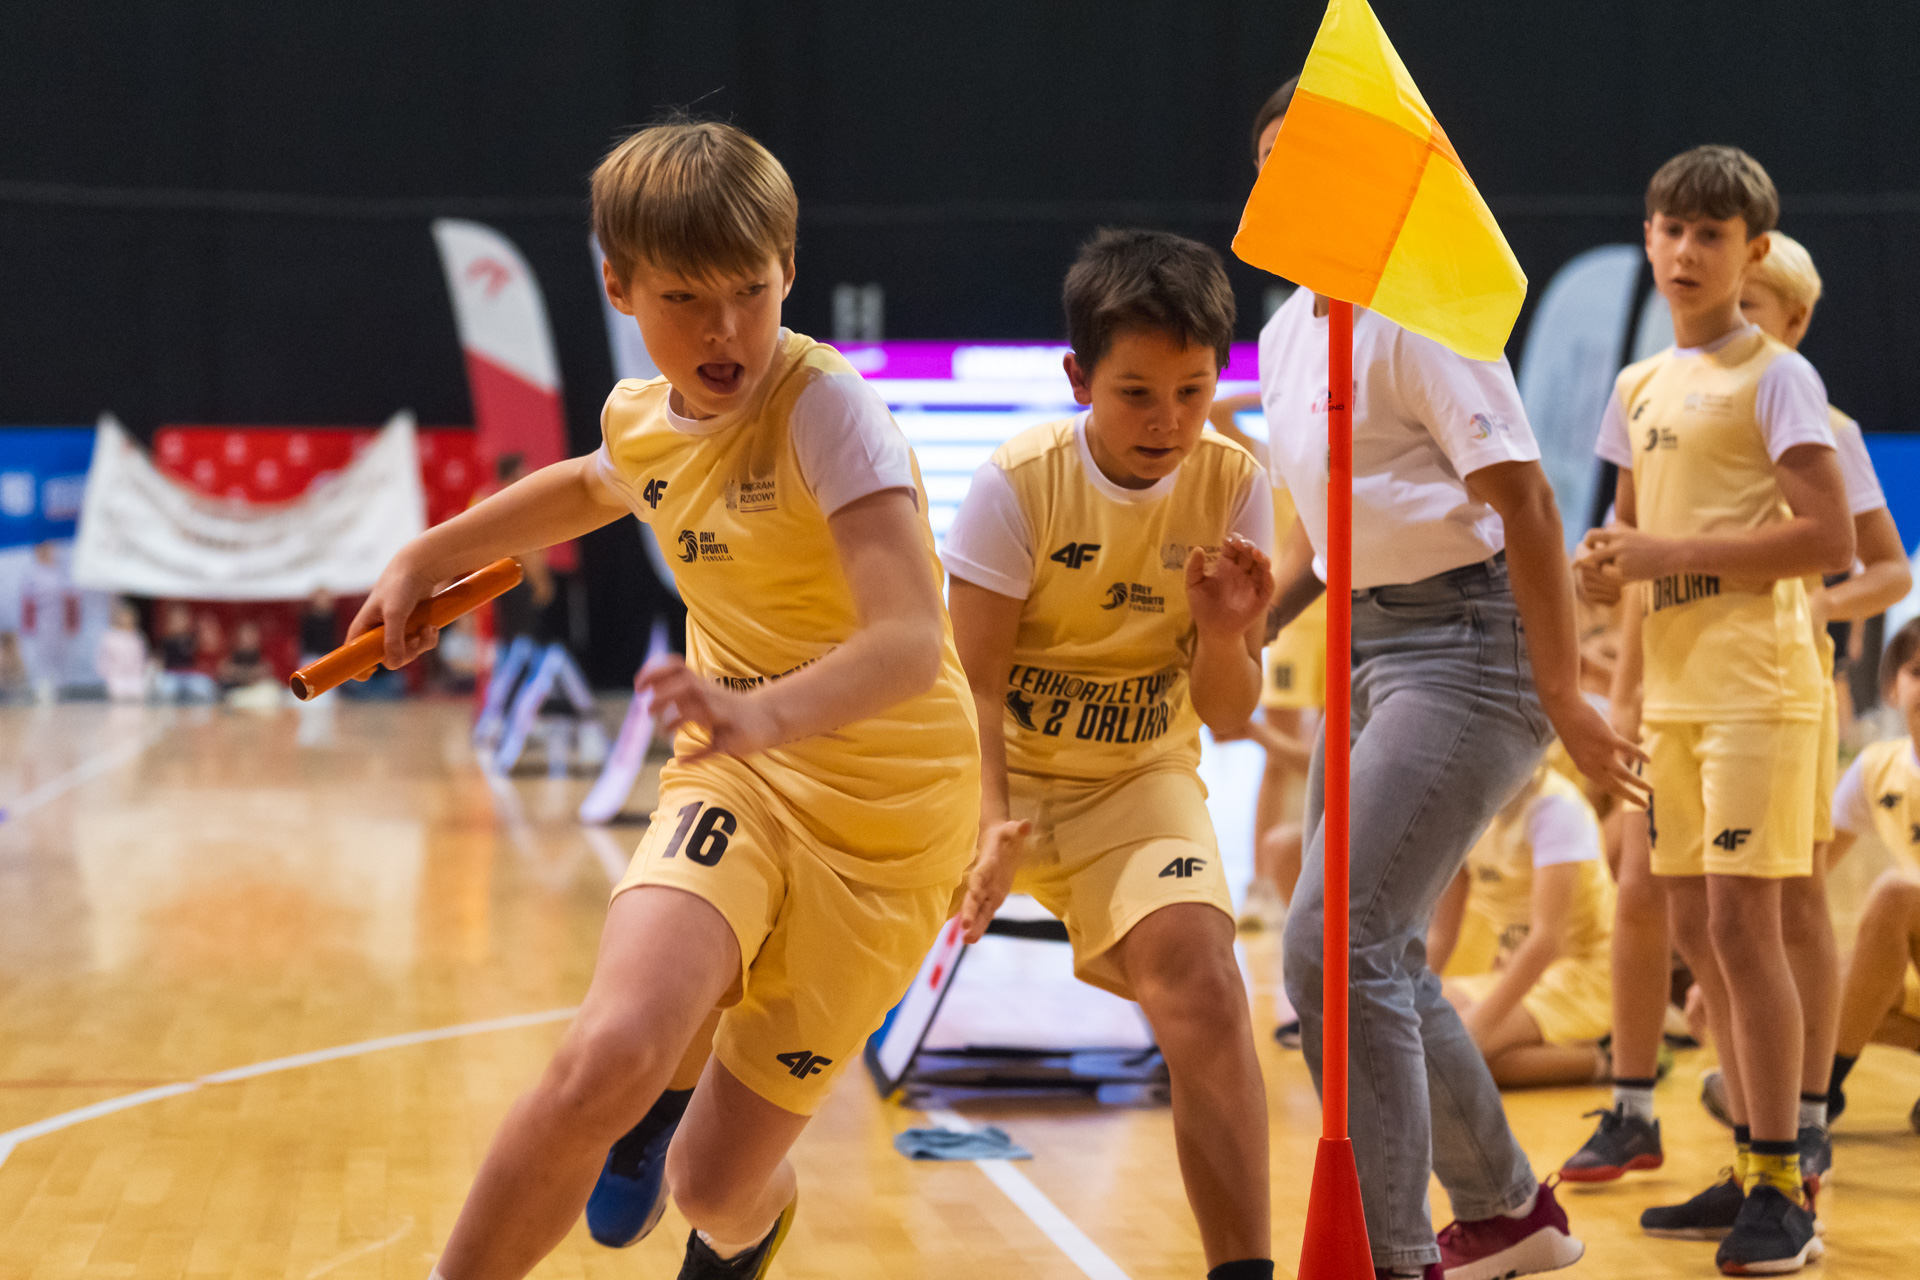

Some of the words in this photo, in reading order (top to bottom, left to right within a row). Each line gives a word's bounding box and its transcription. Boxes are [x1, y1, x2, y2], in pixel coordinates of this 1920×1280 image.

[643, 478, 668, 510] 4F
[741, 481, 775, 492] PRGRAM
[700, 543, 729, 555] SPORTU
[1050, 542, 1101, 569] 4F
[1075, 701, 1169, 744] ORLIKA
[661, 800, 738, 868] 16
[1712, 828, 1752, 851] 4F
[1158, 857, 1207, 879] 4F
[776, 1050, 833, 1080] 4F
